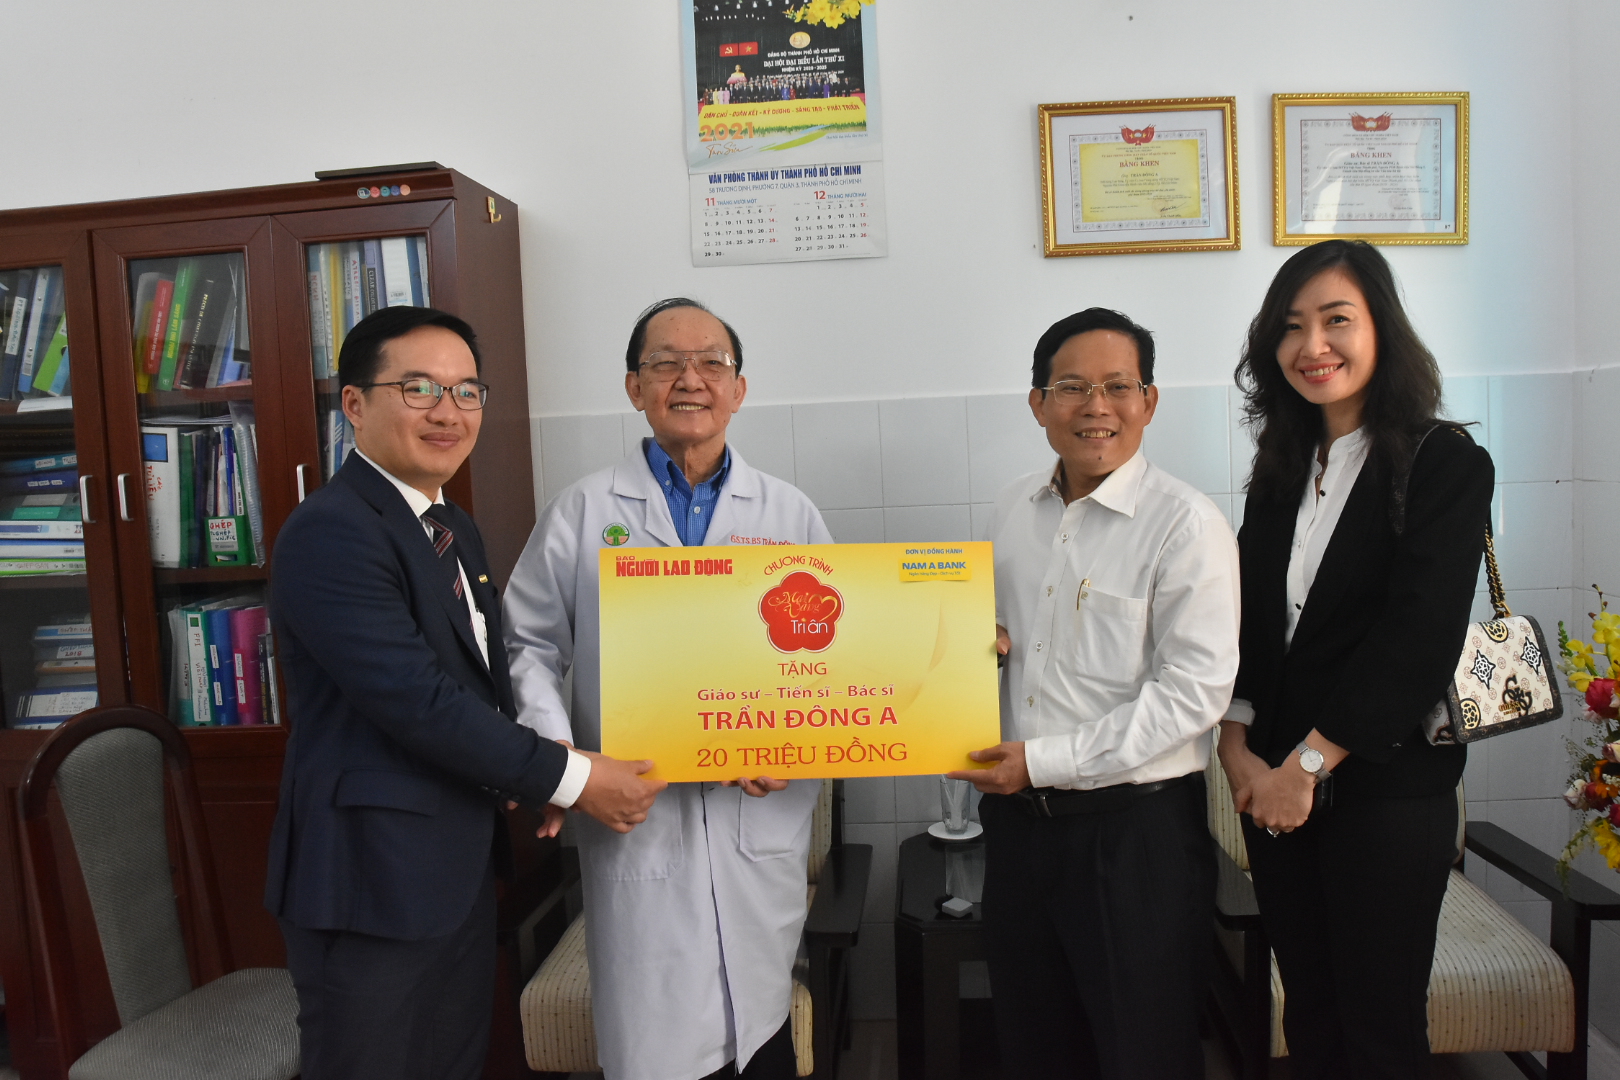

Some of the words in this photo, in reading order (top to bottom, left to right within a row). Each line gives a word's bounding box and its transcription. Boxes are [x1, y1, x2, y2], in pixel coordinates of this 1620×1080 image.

[700, 122, 754, 142] 2021
[709, 172, 721, 184] VĂN
[724, 171, 745, 183] PHÒNG
[747, 170, 768, 181] THÀNH
[770, 168, 779, 180] ỦY
[781, 167, 802, 179] THÀNH
[804, 164, 817, 178] PHỐ
[820, 164, 828, 177] HỒ
[831, 165, 842, 176] CHÍ
[844, 165, 861, 175] MINH
[705, 197, 715, 206] 11
[814, 191, 826, 199] 12
[616, 559, 659, 577] NGƯỜI
[663, 560, 690, 576] LAO
[694, 558, 732, 576] ĐỘNG
[809, 556, 834, 576] TRÌNH
[791, 618, 806, 634] Tri
[808, 619, 828, 634] ân
[777, 660, 827, 679] TẶNG
[697, 688, 736, 701] Giáo
[741, 689, 760, 700] sư
[776, 685, 812, 699] Tiến
[817, 686, 830, 698] sĩ
[848, 685, 876, 696] Bác
[881, 684, 894, 696] sĩ
[698, 705, 776, 730] TRẦN
[784, 705, 871, 729] ĐÔNG
[879, 706, 898, 725] A
[697, 748, 728, 767] 20
[737, 742, 816, 768] TRIỆU
[825, 736, 907, 764] ĐỒNG
